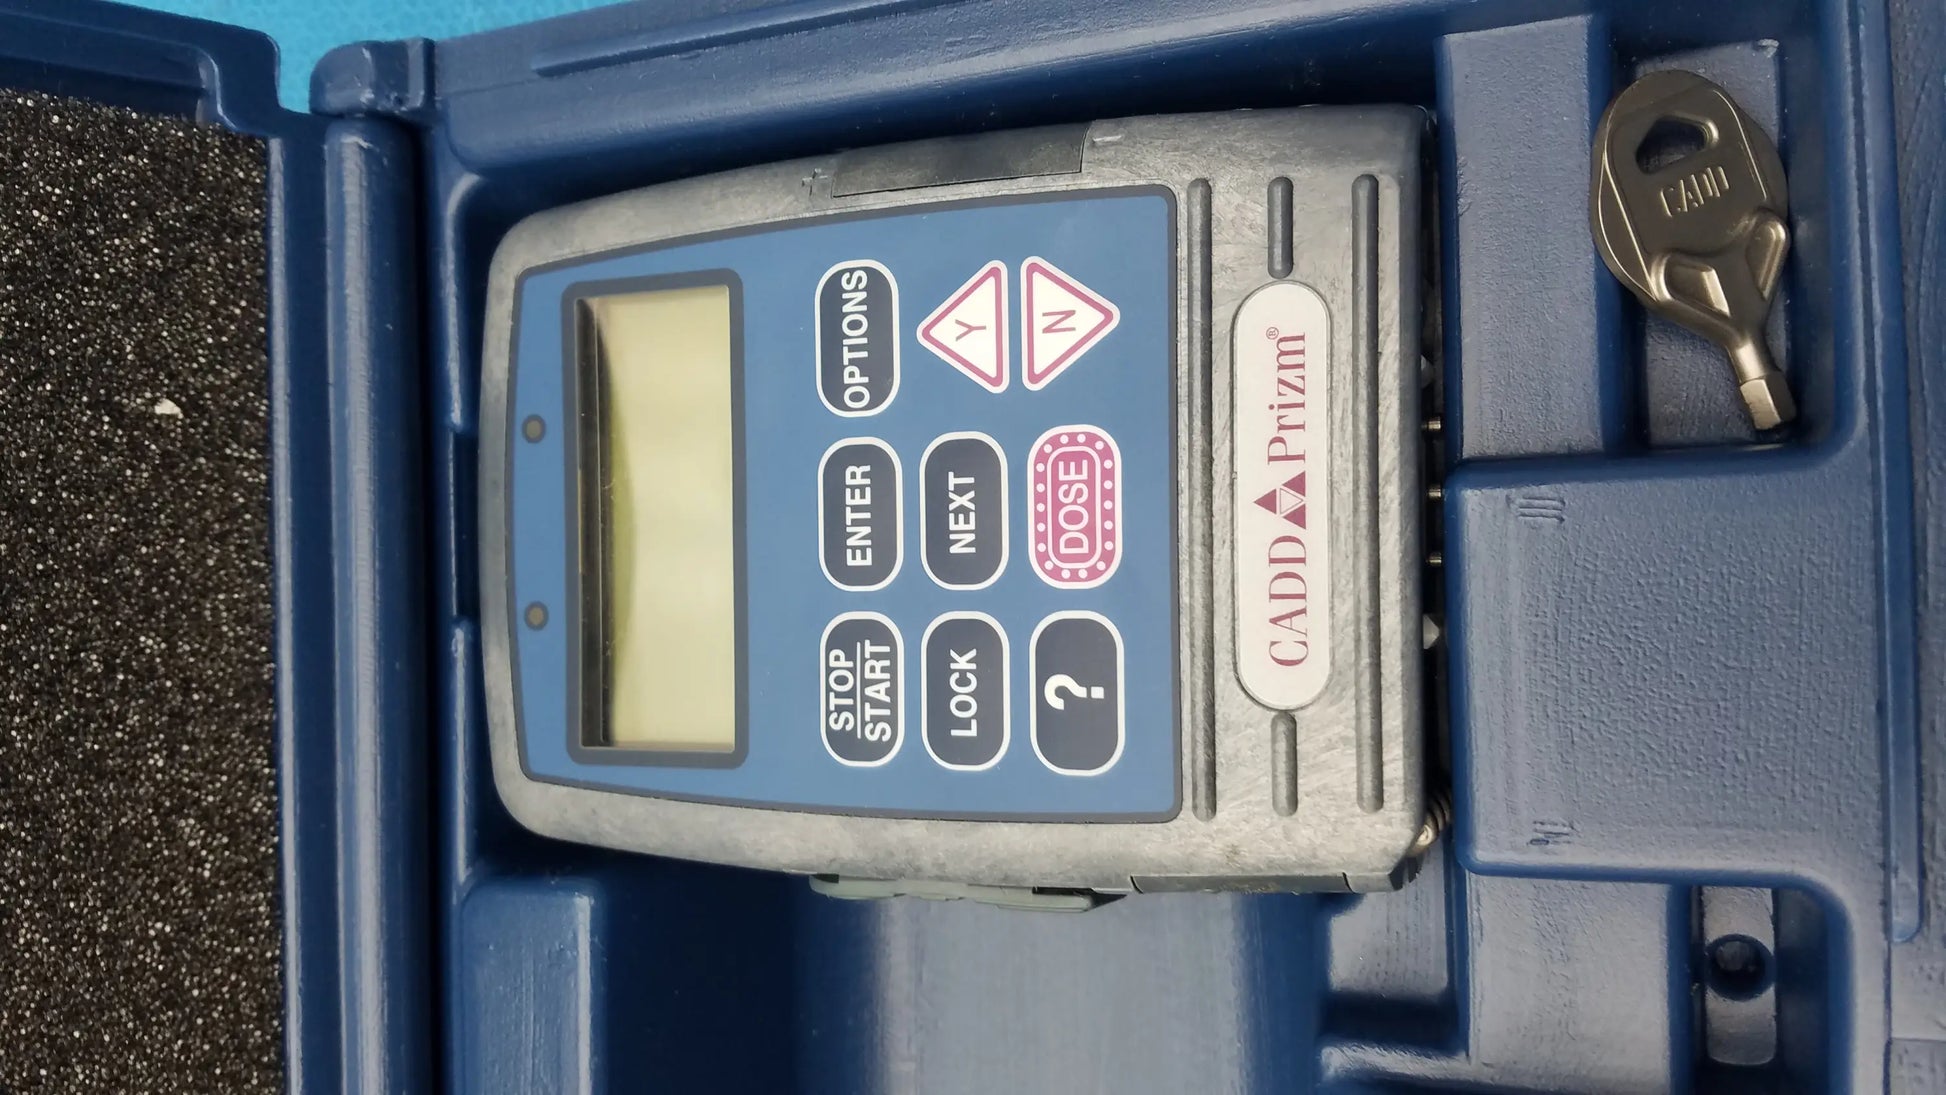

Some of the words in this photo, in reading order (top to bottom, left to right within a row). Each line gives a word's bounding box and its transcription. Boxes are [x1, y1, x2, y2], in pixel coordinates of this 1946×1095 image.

[841, 268, 869, 409] OPTIONS
[955, 319, 986, 341] Y
[1041, 309, 1077, 335] N
[846, 463, 873, 567] ENTER
[949, 471, 976, 554] NEXT
[1058, 459, 1089, 555] DOSE
[1268, 535, 1308, 667] CADD
[829, 647, 854, 731] STOP
[865, 639, 892, 743] START
[950, 648, 978, 738] LOCK
[1044, 674, 1105, 711] ?
